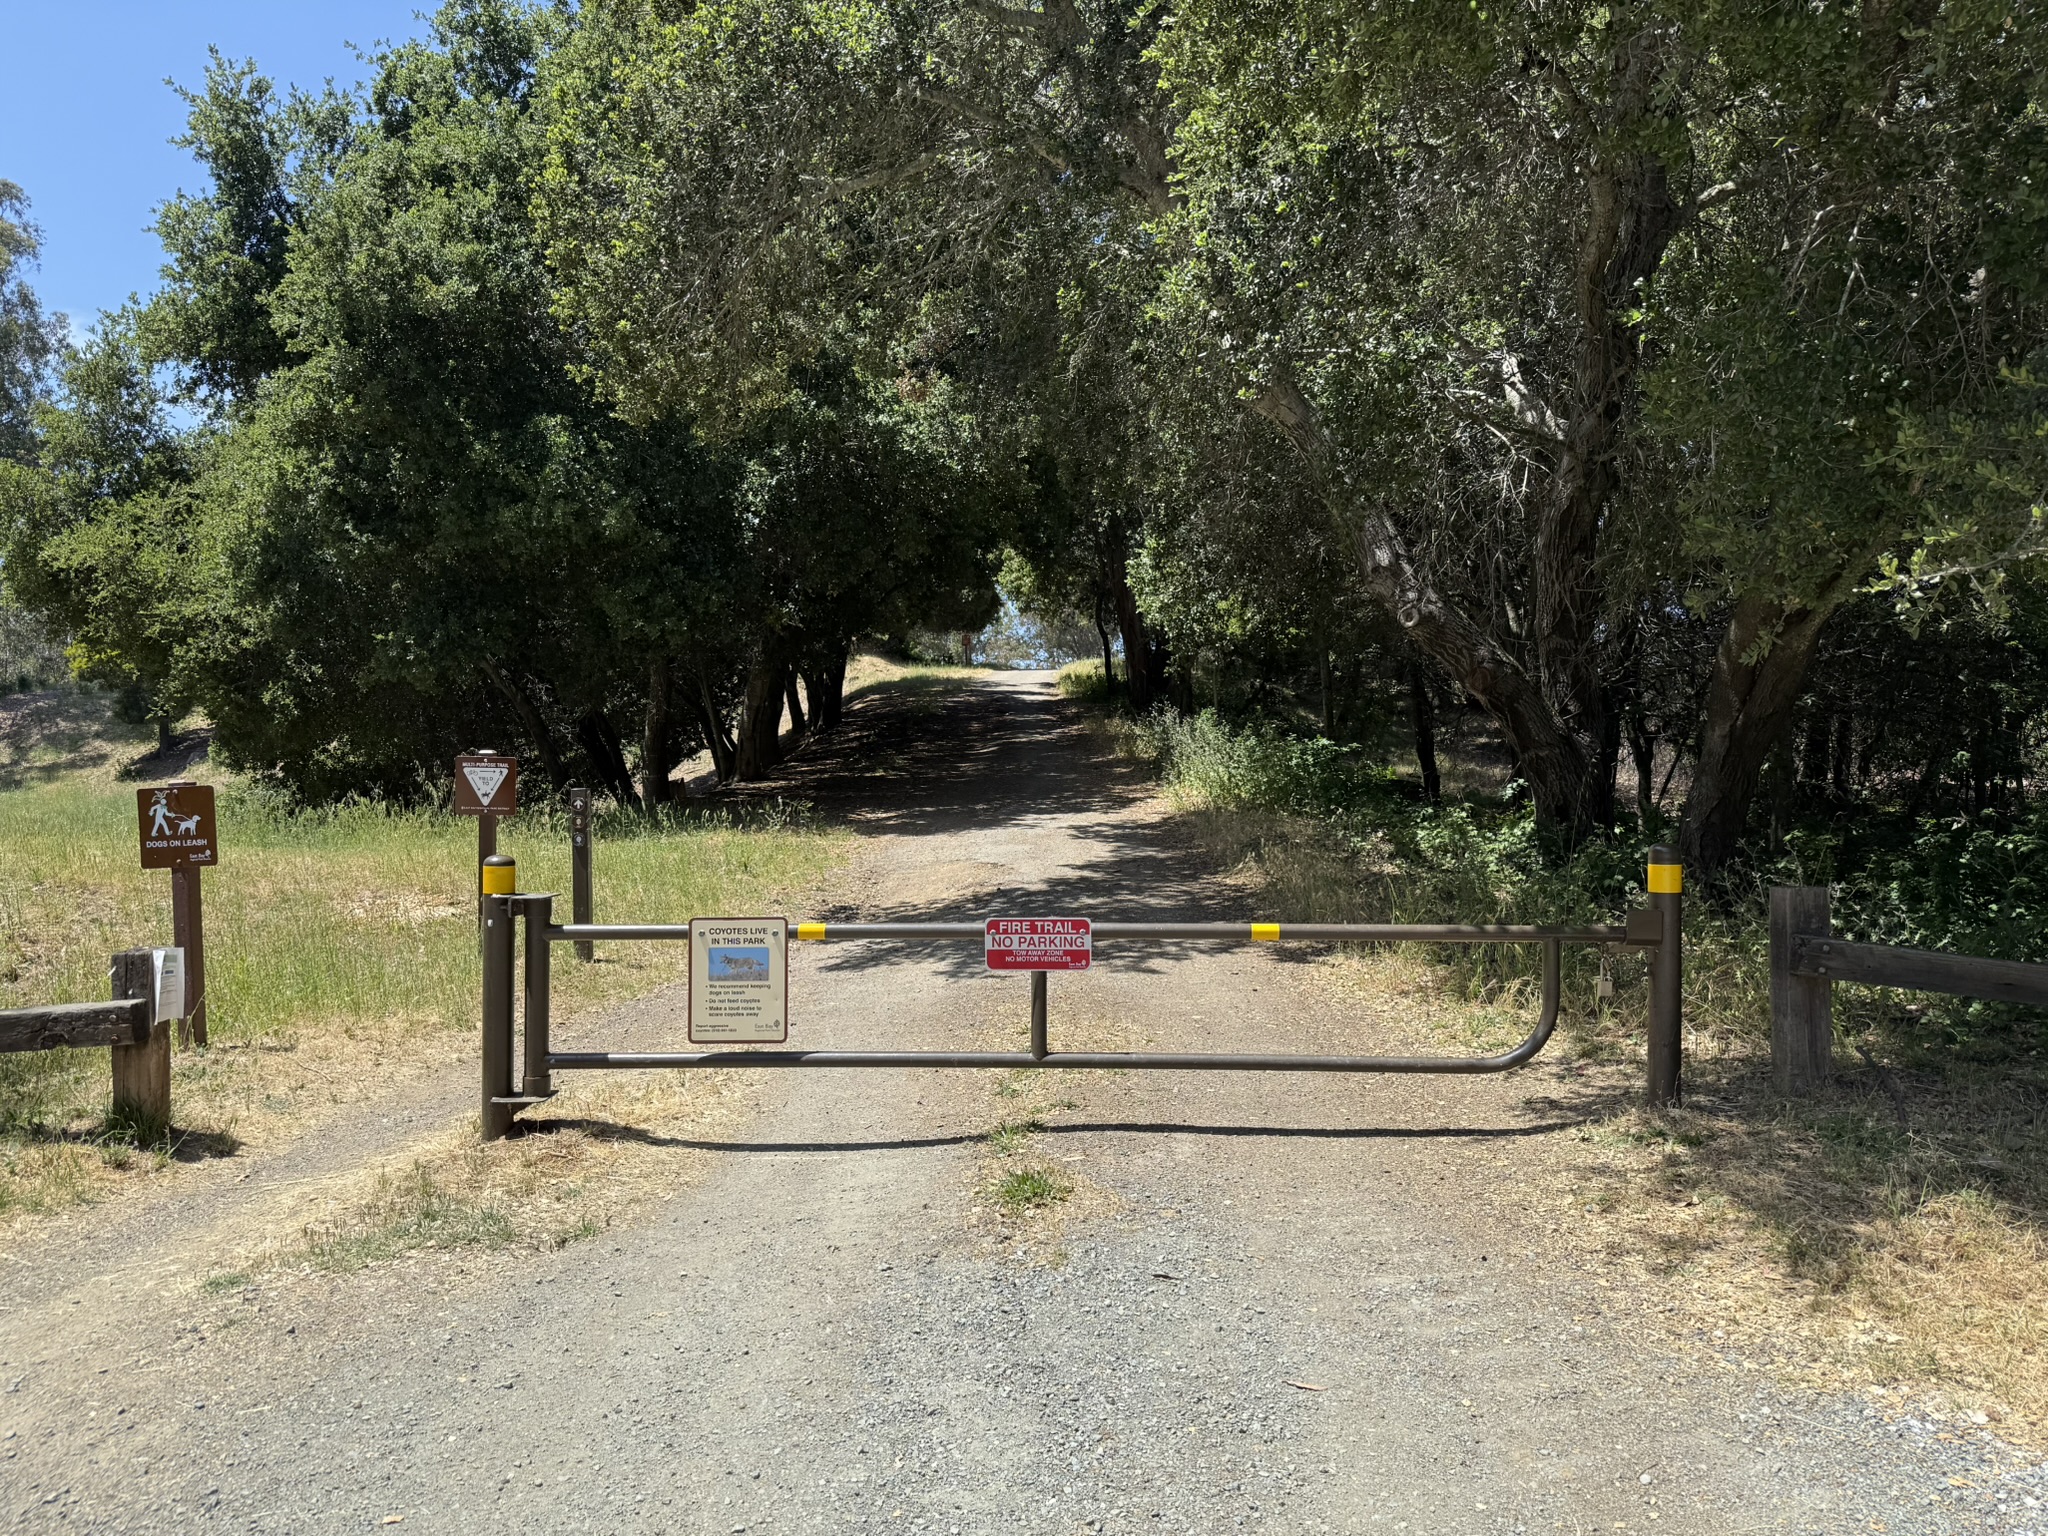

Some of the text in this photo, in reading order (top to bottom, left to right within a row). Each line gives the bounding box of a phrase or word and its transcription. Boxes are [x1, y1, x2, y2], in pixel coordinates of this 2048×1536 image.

[1000, 922, 1076, 933] FIRE TRAIL
[992, 936, 1085, 948] NO PARKING
